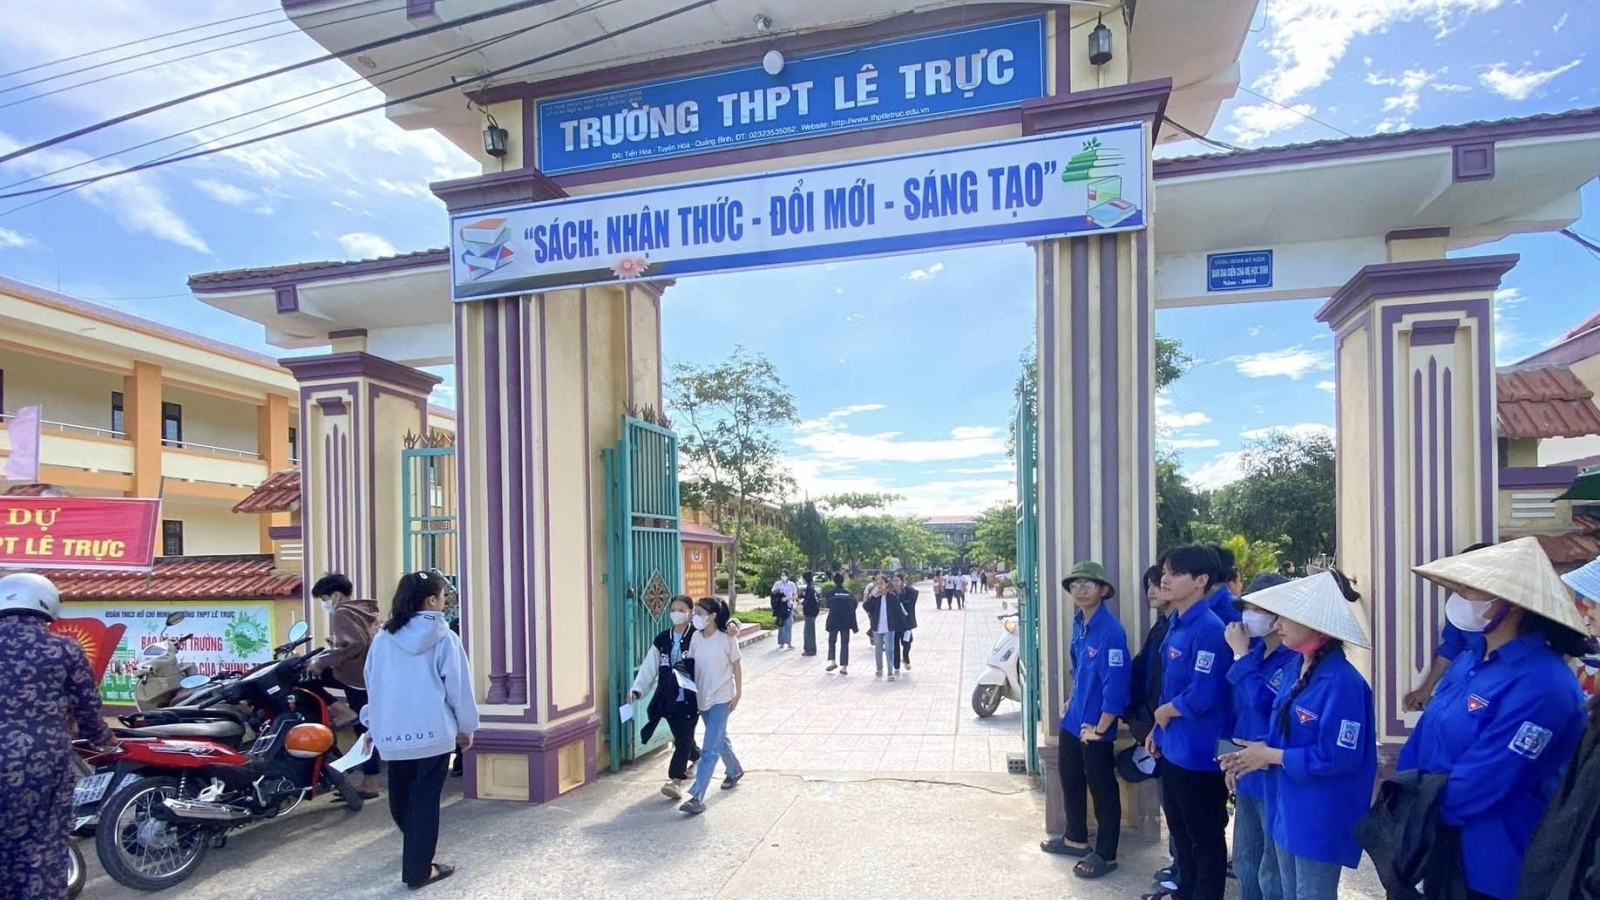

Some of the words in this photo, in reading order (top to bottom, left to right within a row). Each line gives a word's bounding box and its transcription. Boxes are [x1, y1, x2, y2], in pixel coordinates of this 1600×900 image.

[559, 101, 699, 151] TRƯỜNG
[717, 81, 814, 127] THPT
[834, 63, 879, 111] LÊ
[899, 49, 1015, 99] TRỰC
[606, 205, 670, 258] NHẬN
[677, 196, 743, 247] THỨC
[752, 217, 761, 226] -
[769, 178, 814, 236] ĐỔI
[823, 177, 875, 231] MỚI
[885, 201, 894, 209] -
[903, 169, 978, 221] SÁNG
[6, 507, 62, 531] DỰ
[25, 534, 55, 556] LÊ
[62, 538, 126, 561] TRỰC
